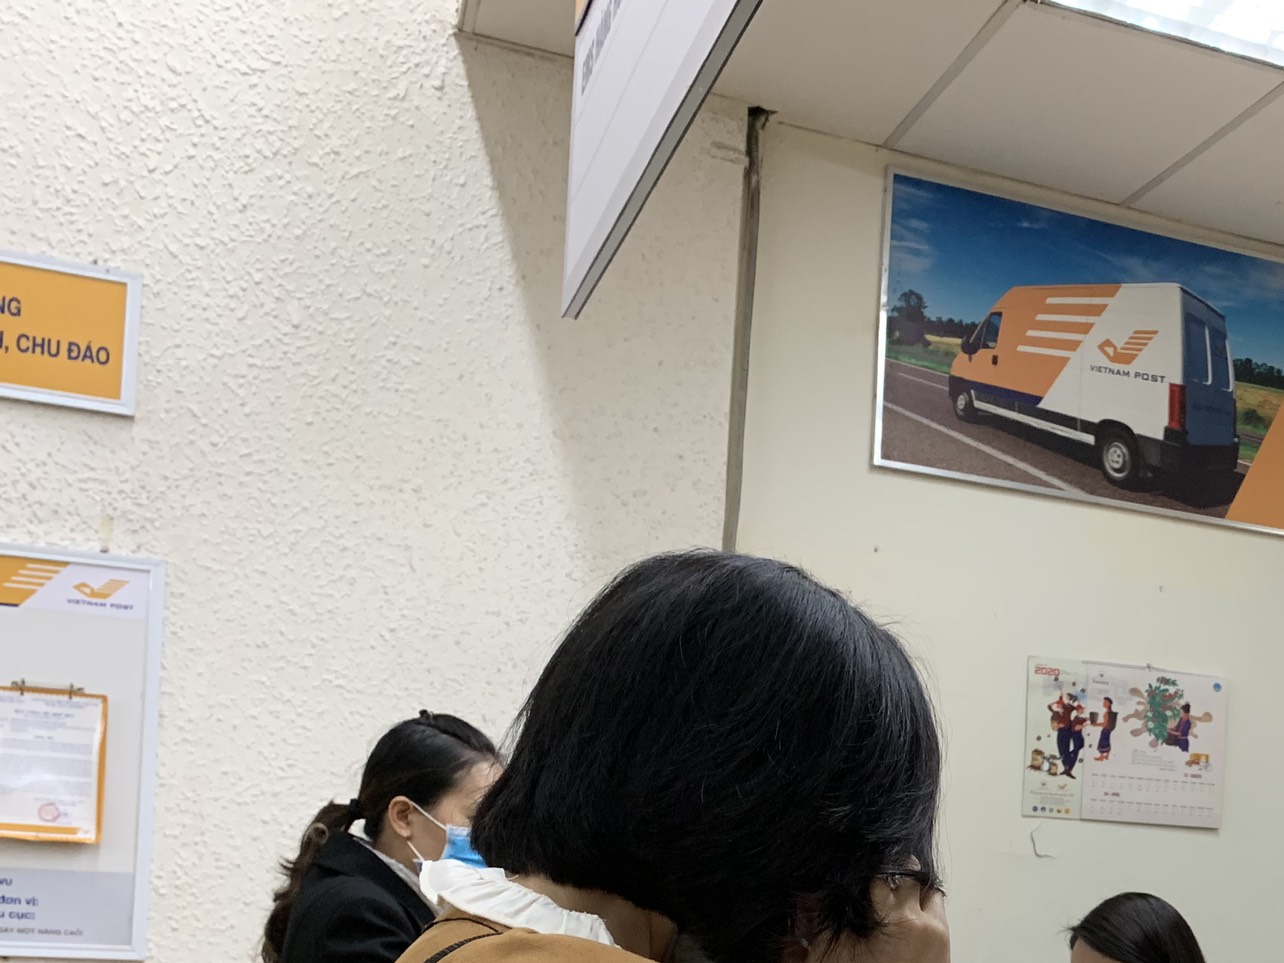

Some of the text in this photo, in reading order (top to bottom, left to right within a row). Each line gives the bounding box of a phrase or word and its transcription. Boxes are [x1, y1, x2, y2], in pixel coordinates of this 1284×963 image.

[16, 333, 60, 357] CHU
[67, 340, 110, 365] ĐÁO
[1089, 364, 1166, 384] VIETNAM POST
[1034, 665, 1061, 677] 2020
